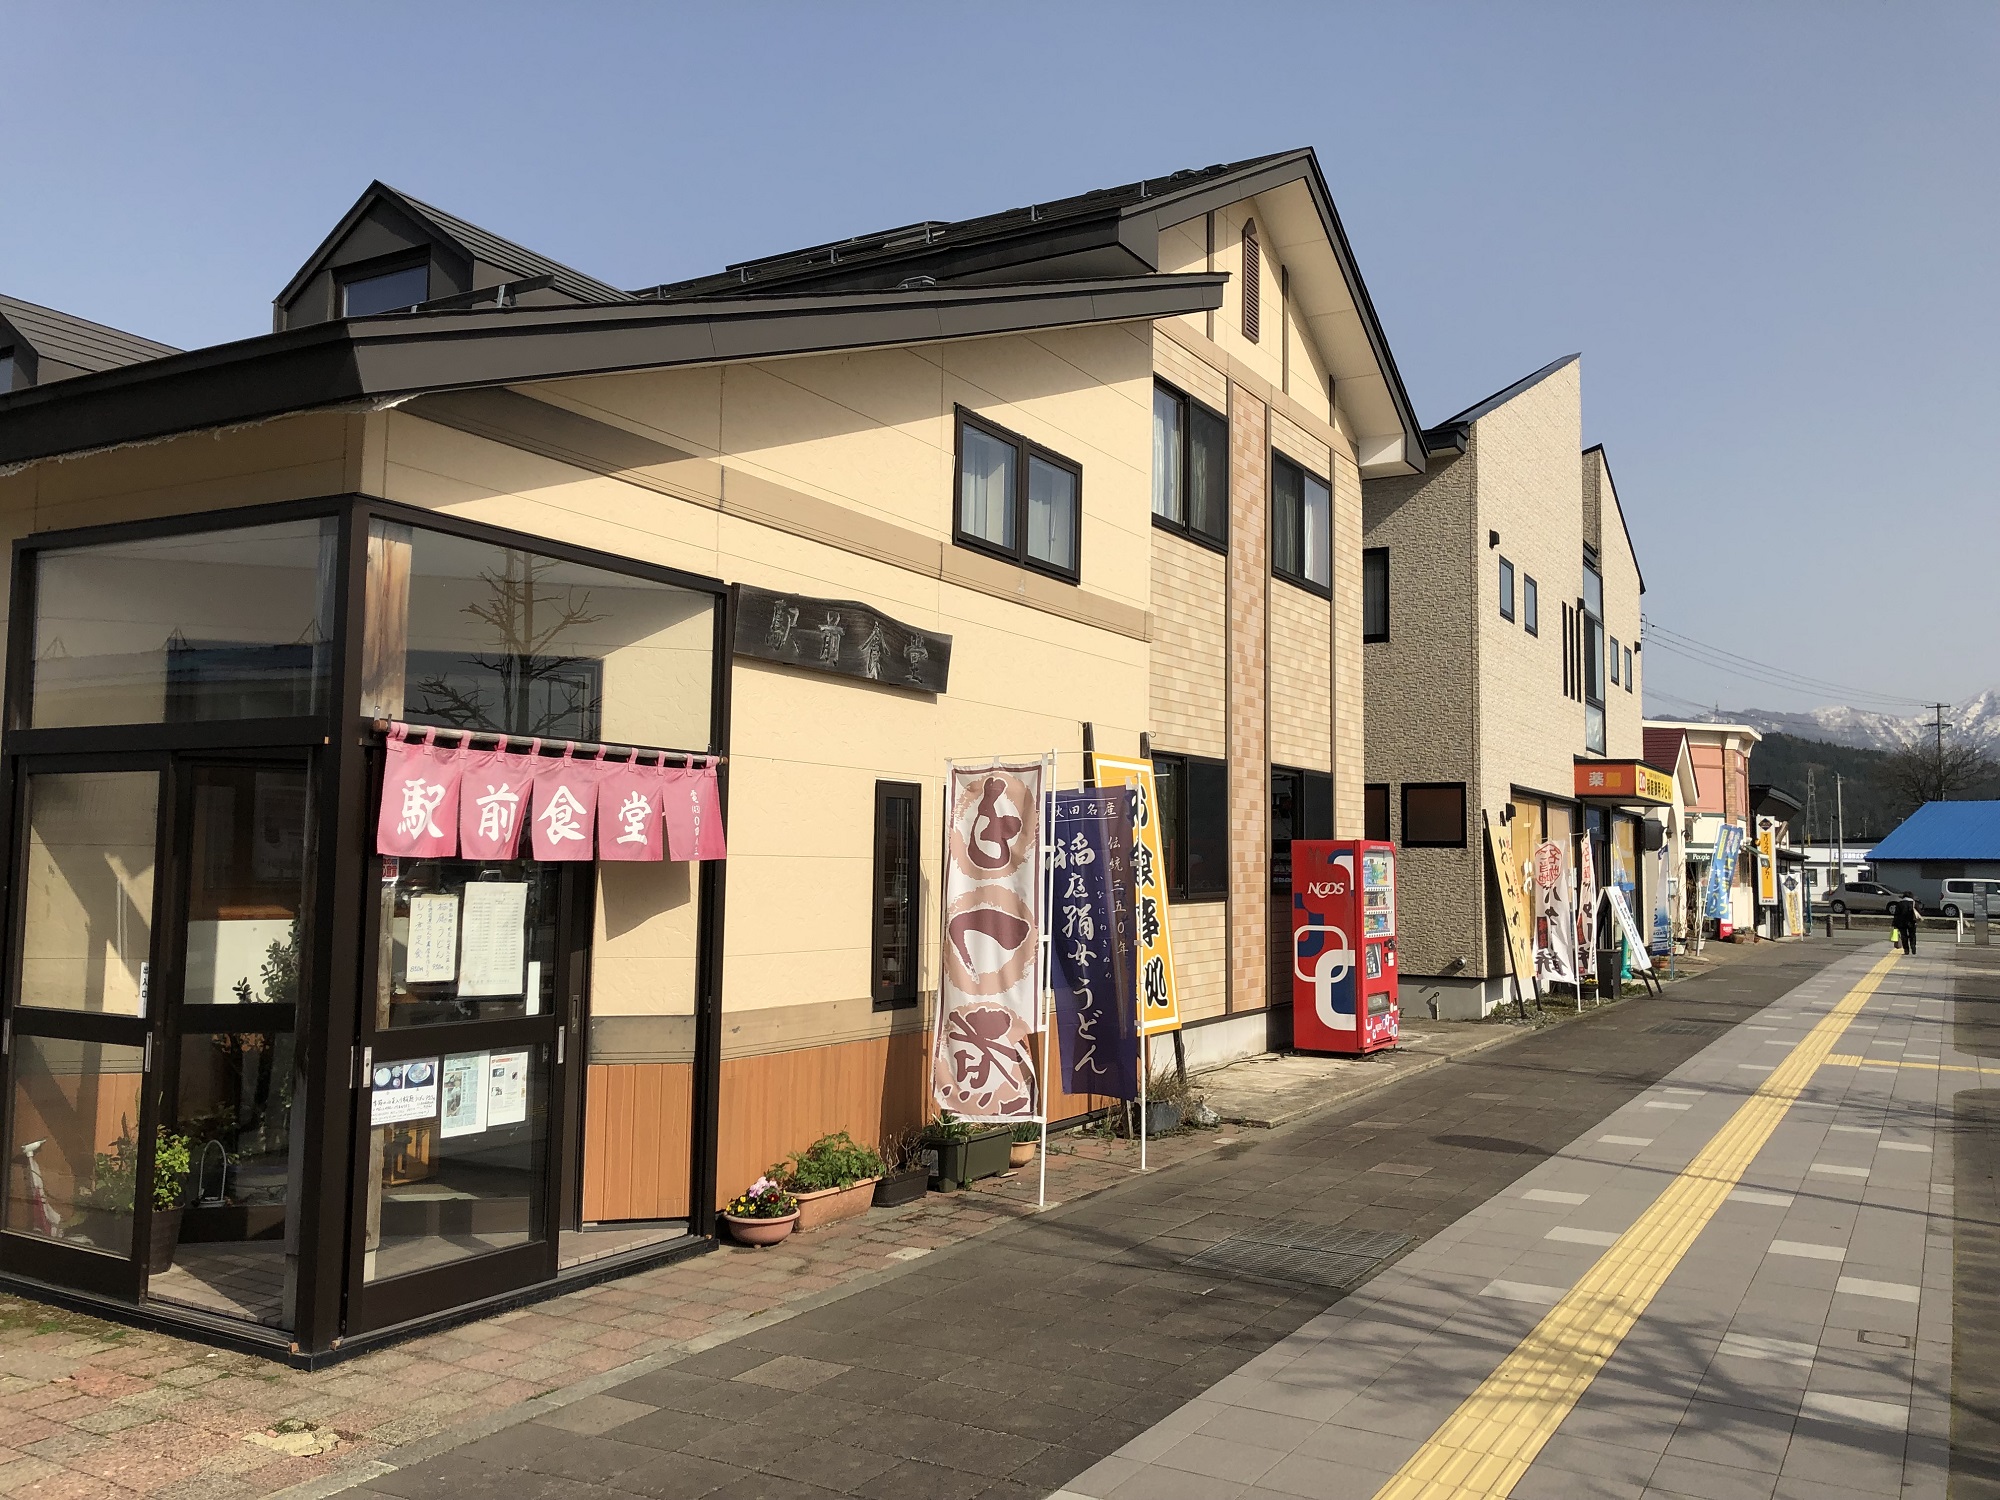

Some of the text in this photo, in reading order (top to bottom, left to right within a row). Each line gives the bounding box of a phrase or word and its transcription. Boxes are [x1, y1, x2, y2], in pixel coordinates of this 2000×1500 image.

[1588, 771, 1604, 787] 薬
[397, 779, 652, 845] 駅前食堂
